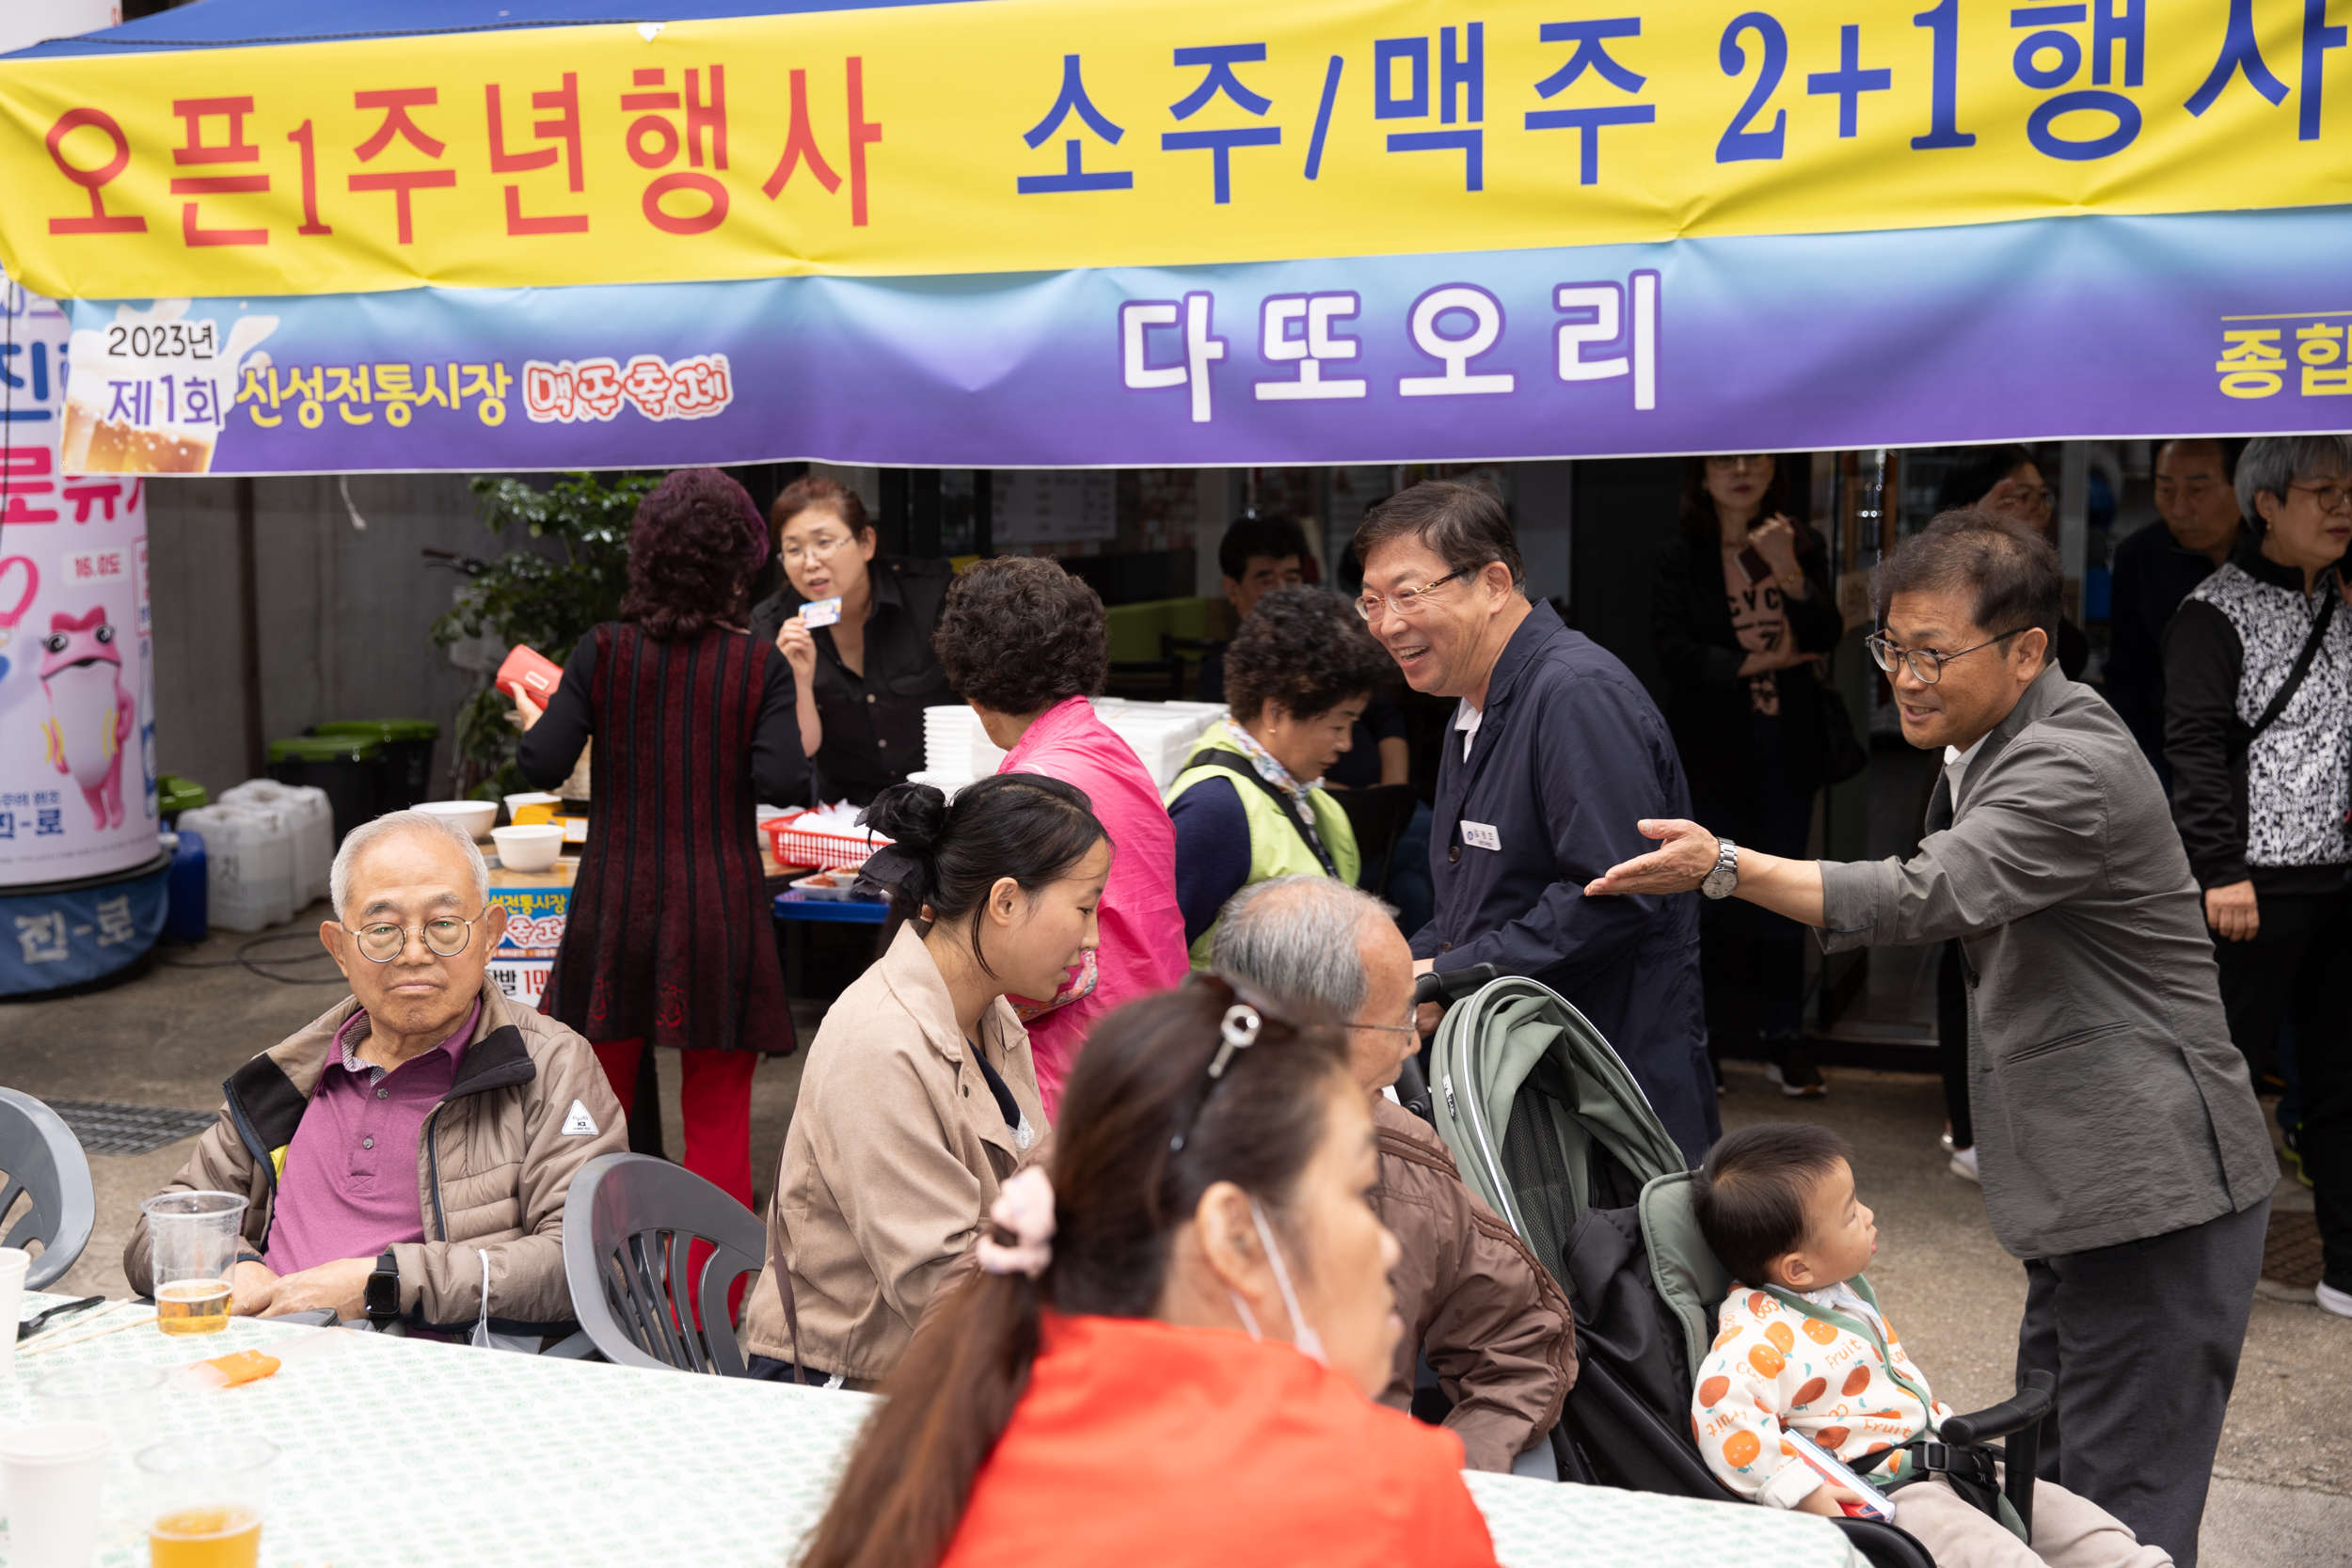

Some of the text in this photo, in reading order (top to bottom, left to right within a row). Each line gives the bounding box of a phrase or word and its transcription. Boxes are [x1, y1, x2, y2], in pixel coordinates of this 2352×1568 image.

[45, 0, 2347, 248] 오픈1주년행사 소주/맥주 2+1행사
[108, 325, 213, 359] 2023년
[1120, 271, 1658, 422] 다또오리
[2216, 323, 2352, 400] 종합
[107, 374, 220, 426] 제1회
[235, 359, 730, 429] 신성전통시장 맥주축제
[1824, 1338, 1863, 1370] Fruit
[1863, 1418, 1913, 1439] Fruit
